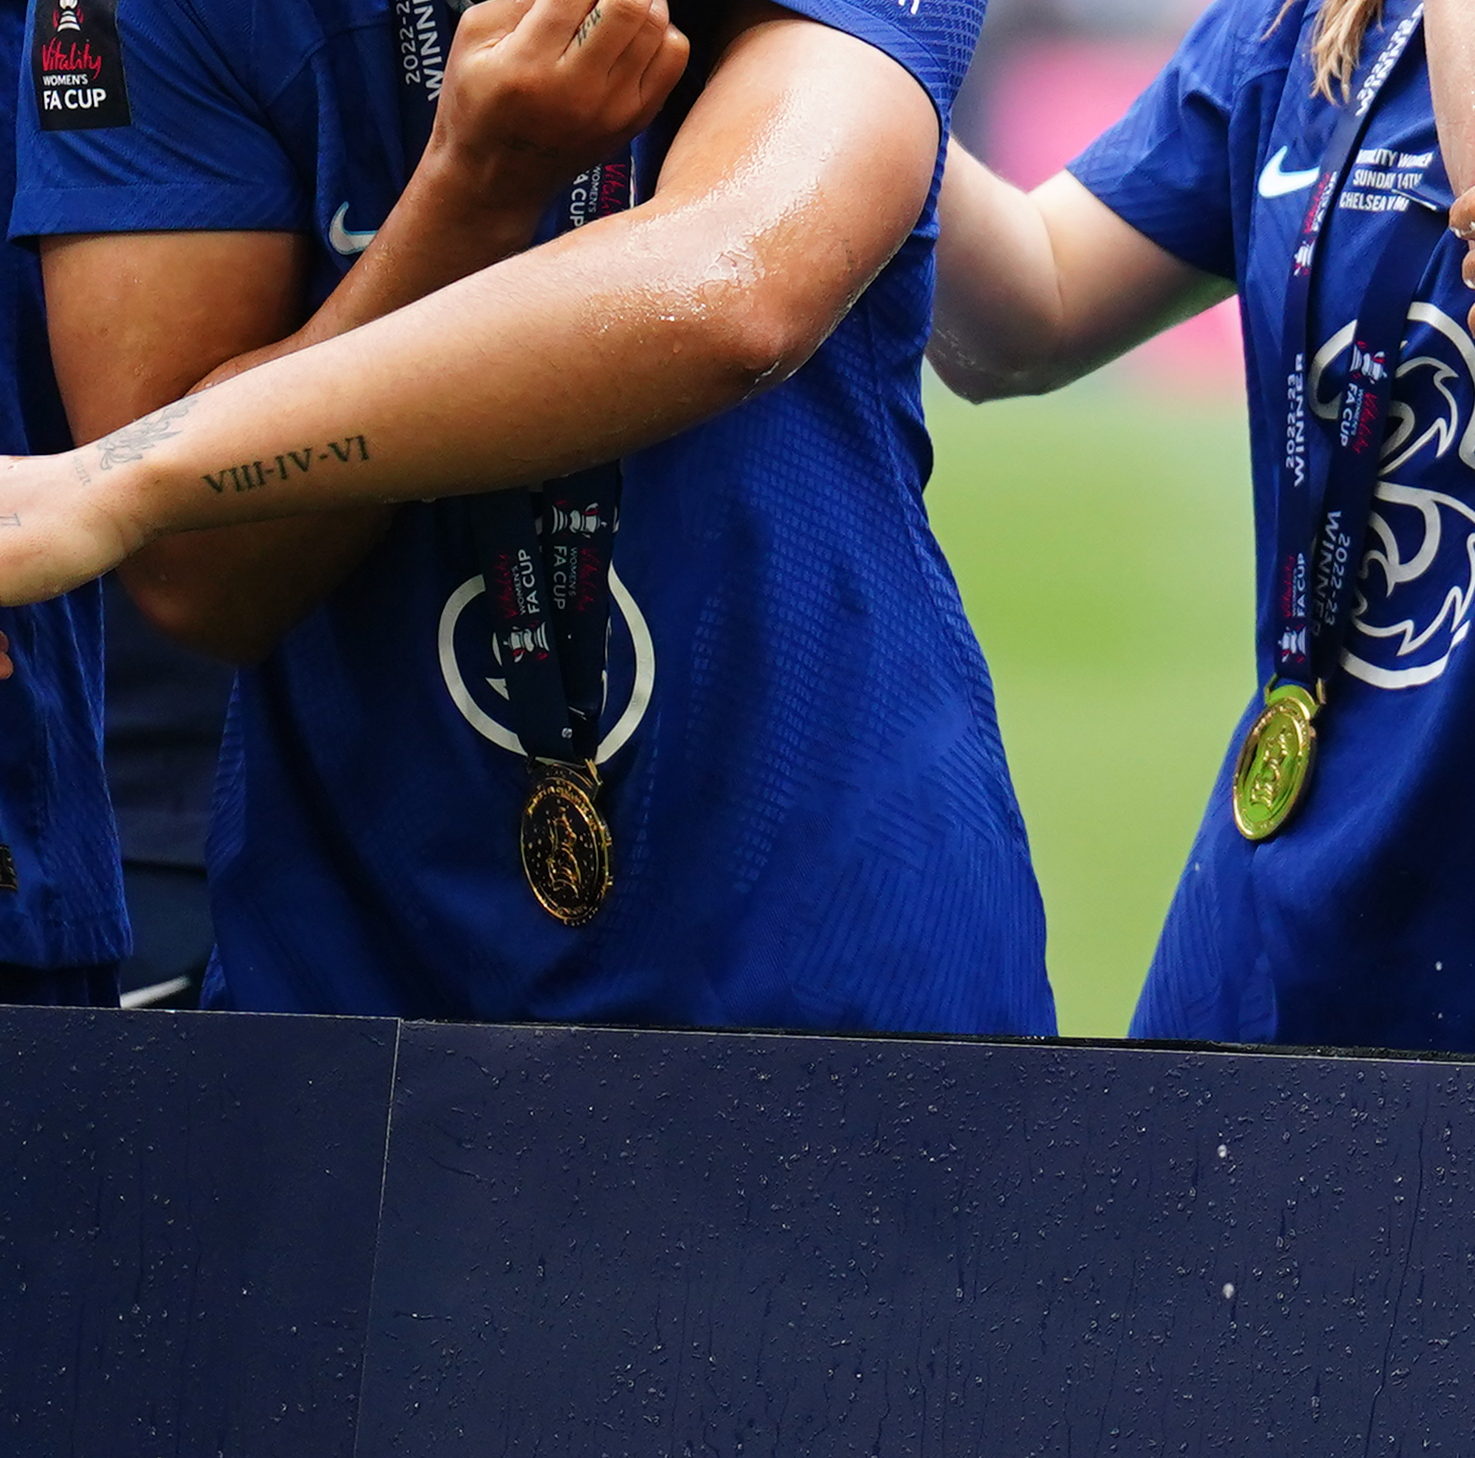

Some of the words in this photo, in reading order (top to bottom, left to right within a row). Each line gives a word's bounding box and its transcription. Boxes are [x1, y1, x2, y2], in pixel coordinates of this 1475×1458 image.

[42, 37, 102, 80] Vitality
[42, 73, 89, 87] WOMEN'S
[43, 89, 63, 111] FA
[64, 87, 107, 110] CUP
[1352, 169, 1396, 190] SUNDAY
[569, 187, 587, 227] CUP
[1339, 191, 1386, 211] CHELSEA
[1344, 382, 1359, 405] FA
[1293, 352, 1305, 488] WINNER
[1339, 407, 1354, 447] CUP
[517, 548, 536, 588] CUP
[553, 544, 568, 568] FA
[1297, 552, 1306, 592] CUP
[552, 570, 567, 611] CUP
[1323, 532, 1351, 626] 2022-23
[526, 589, 541, 615] FA
